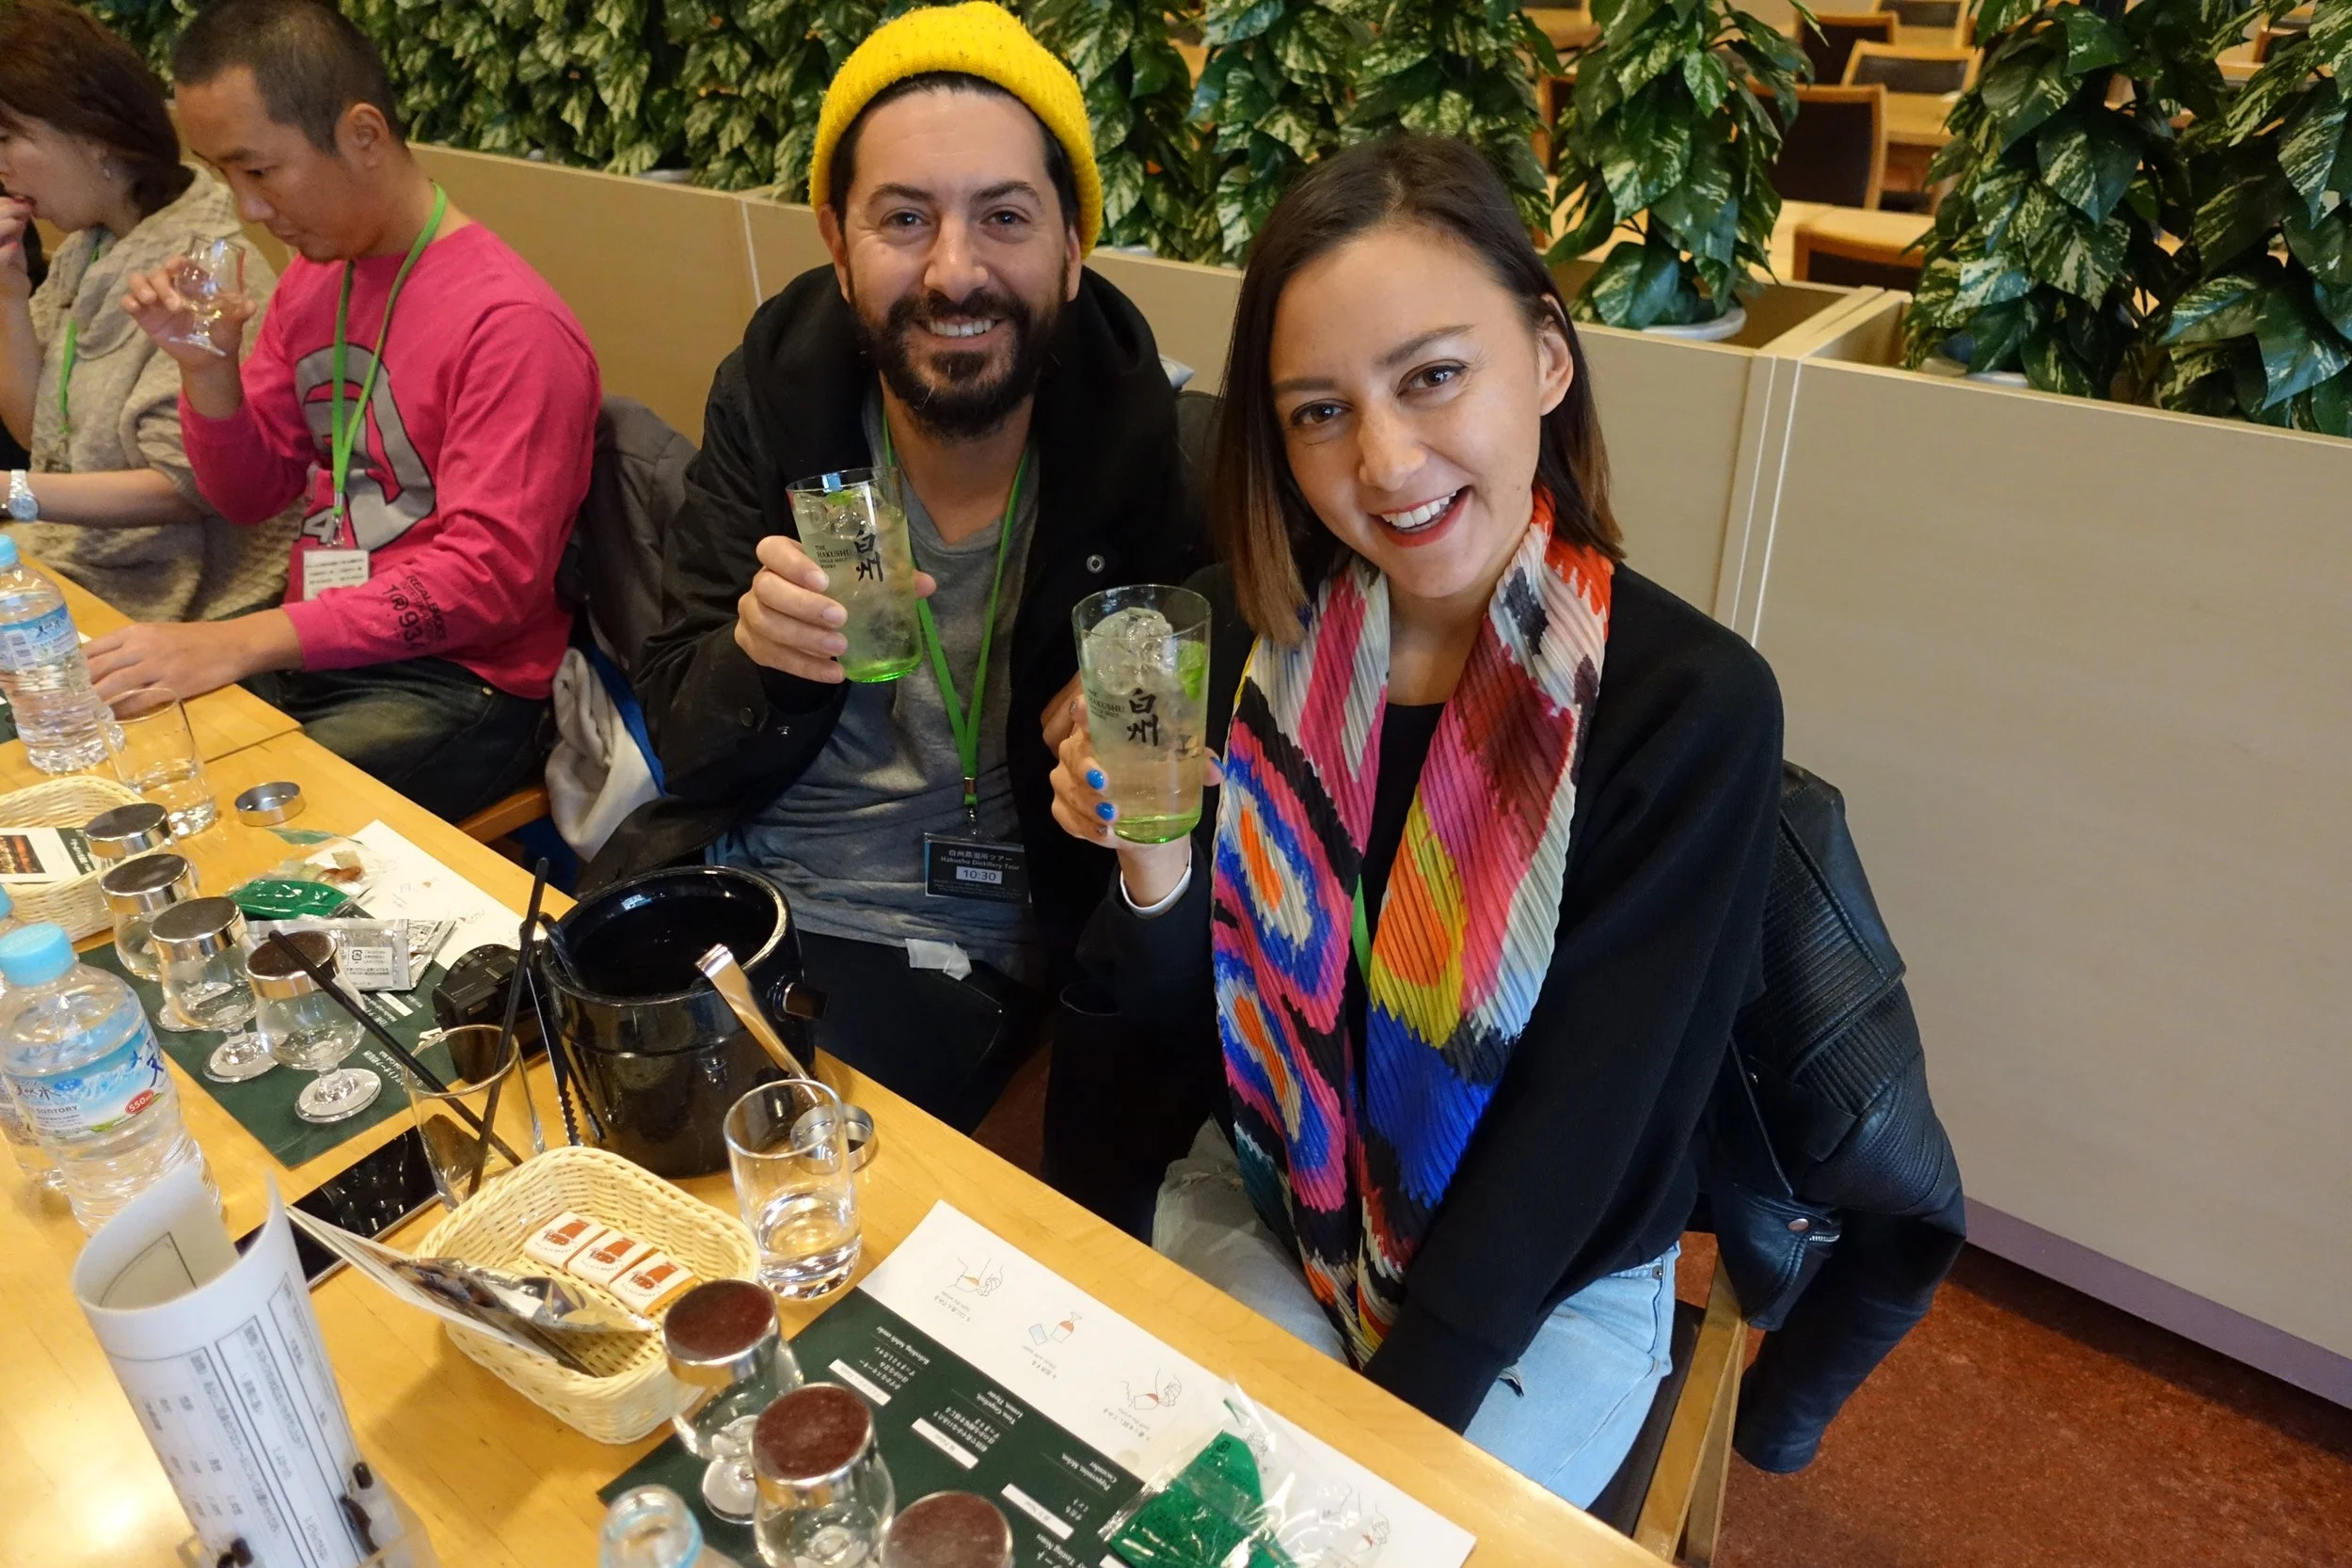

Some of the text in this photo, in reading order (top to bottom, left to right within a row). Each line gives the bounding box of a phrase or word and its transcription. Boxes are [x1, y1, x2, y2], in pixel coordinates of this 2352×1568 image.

[817, 549, 852, 559] HAKUSHU
[854, 529, 883, 582] 白州
[1127, 688, 1158, 747] 白州
[941, 856, 971, 865] Hakushu
[972, 859, 1003, 870] Distillery
[962, 869, 996, 881] 10:30
[36, 1105, 78, 1115] SUNTORY
[1089, 1462, 1117, 1483] Cucumber
[1037, 1534, 1054, 1550] Notes
